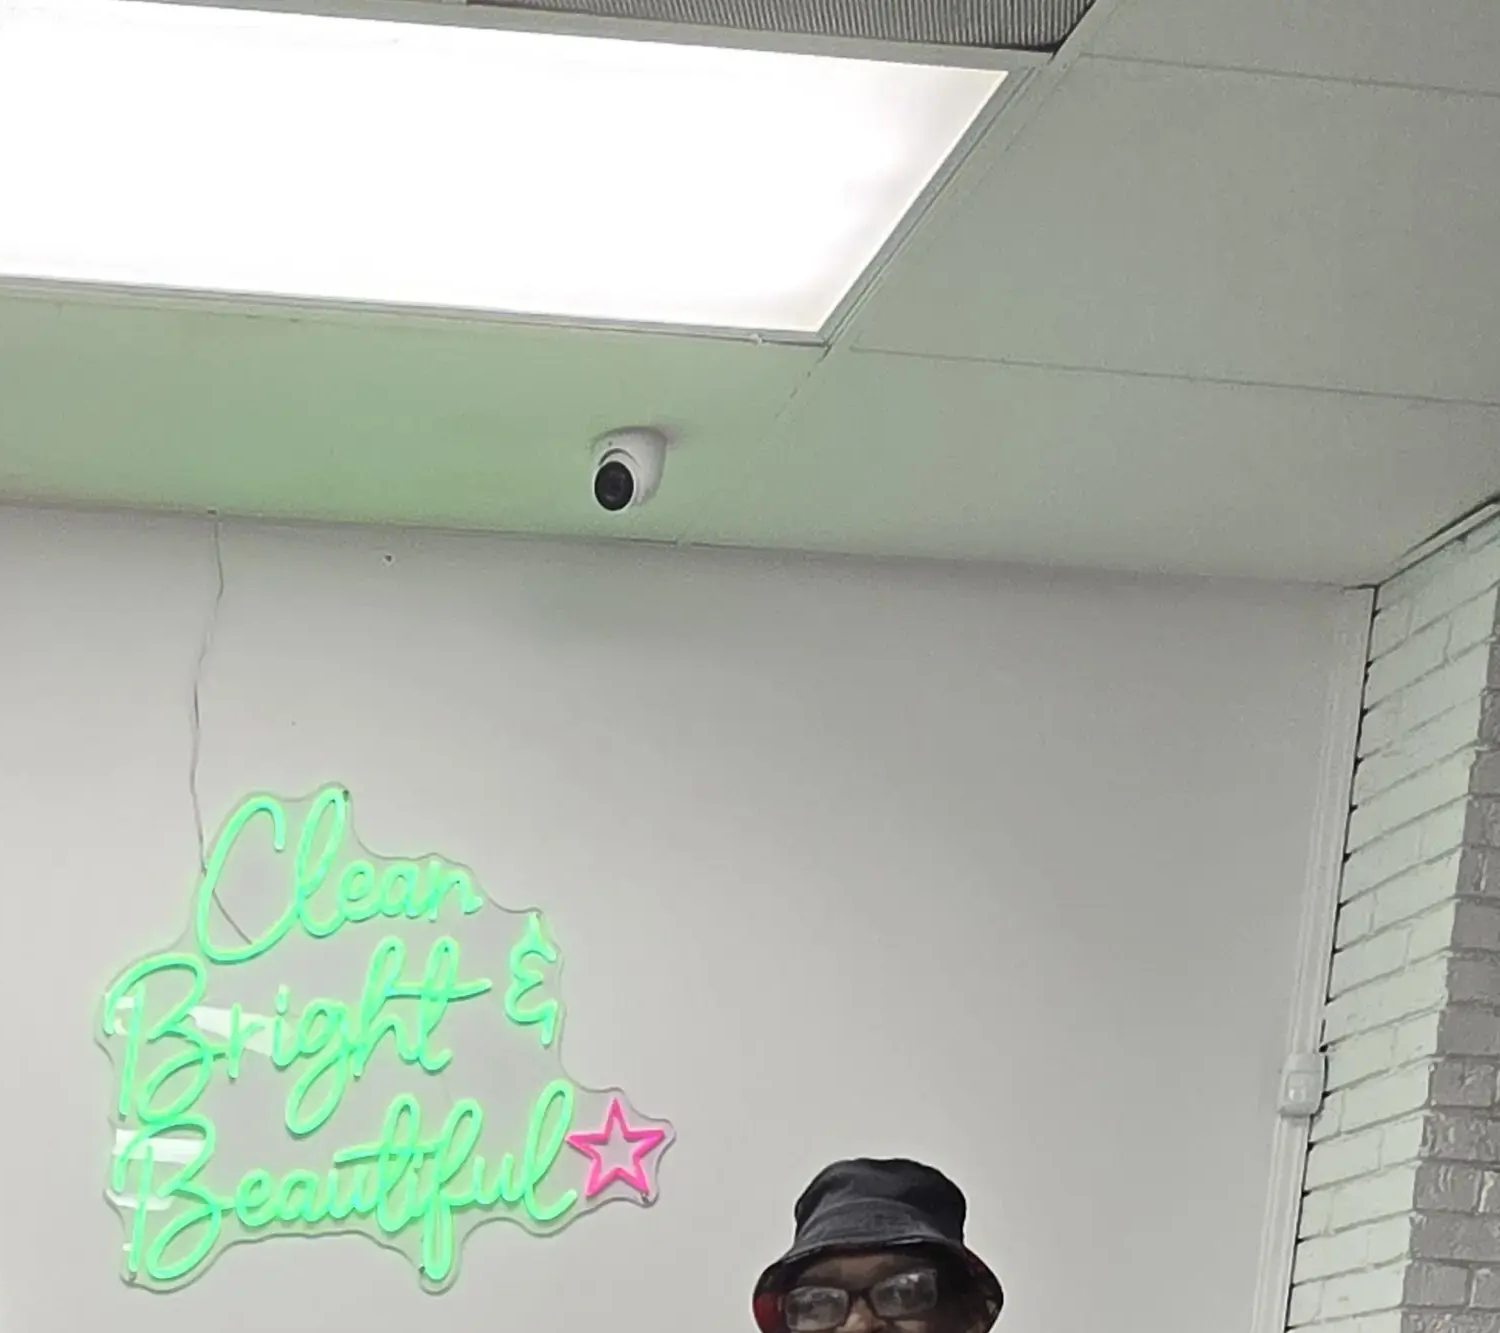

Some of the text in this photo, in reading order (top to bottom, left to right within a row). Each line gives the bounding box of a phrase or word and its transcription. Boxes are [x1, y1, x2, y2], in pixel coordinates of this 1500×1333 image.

[196, 787, 484, 964] Clean
[103, 910, 559, 1136] Bright &
[112, 1079, 579, 1283] Beautiful
